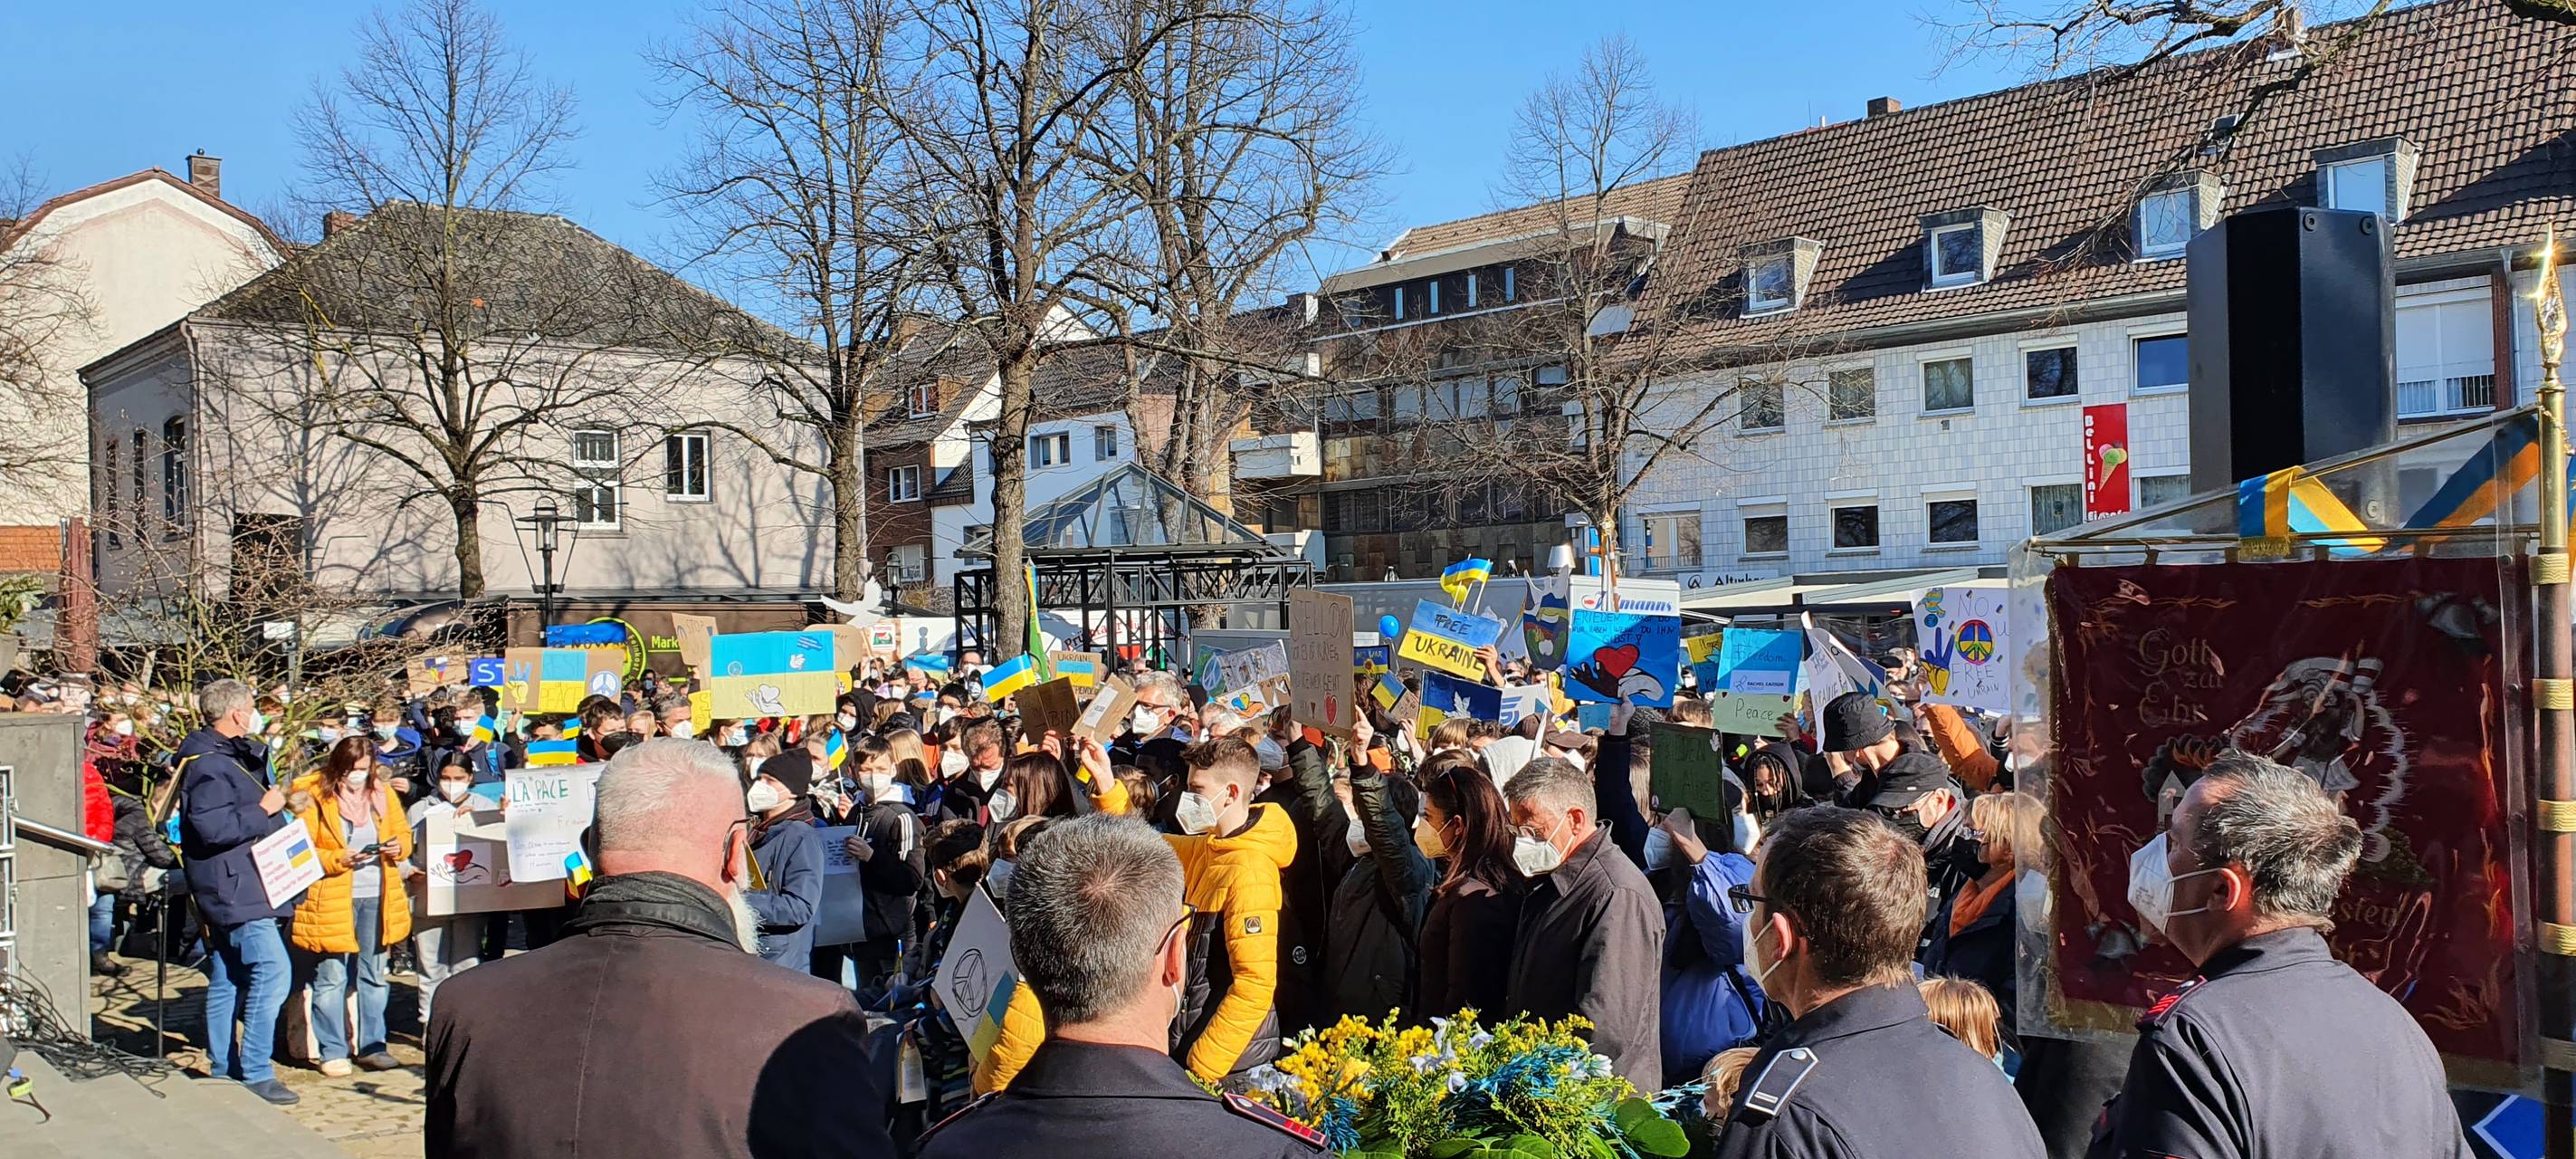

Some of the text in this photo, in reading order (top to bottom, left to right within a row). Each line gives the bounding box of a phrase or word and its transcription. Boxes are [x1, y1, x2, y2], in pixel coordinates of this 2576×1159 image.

[1957, 595, 1989, 618] NO
[1436, 613, 1473, 636] FREE
[1057, 653, 1093, 662] UKRAINE
[1951, 663, 1995, 684] FREE
[1735, 697, 1773, 721] Peace
[512, 778, 569, 803] LA PACE
